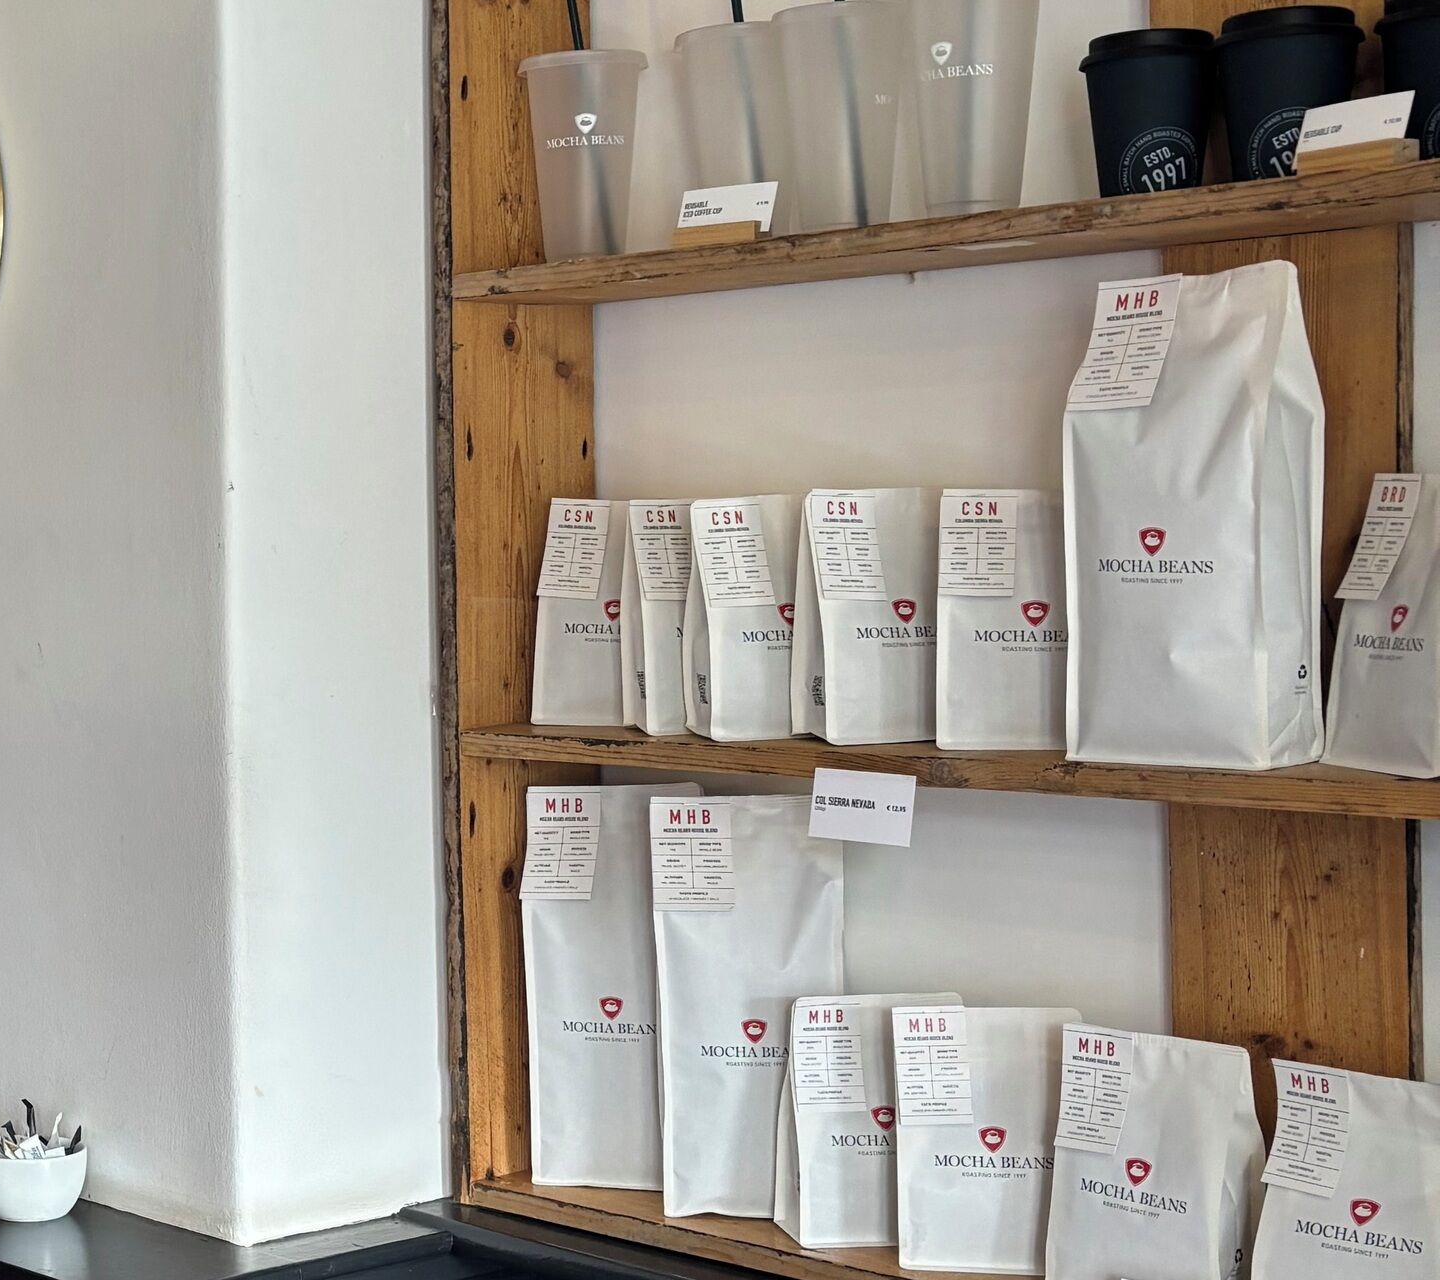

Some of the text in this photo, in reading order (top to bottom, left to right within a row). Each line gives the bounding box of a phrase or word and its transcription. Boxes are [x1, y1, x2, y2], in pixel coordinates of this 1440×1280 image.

[947, 64, 994, 78] BEANS
[546, 135, 625, 150] MOCHA BEANS
[1143, 146, 1175, 168] ESTD.
[1141, 156, 1186, 192] 1997
[564, 509, 593, 523] CSN
[827, 501, 857, 516] CSN
[962, 501, 997, 516] CSN
[646, 510, 676, 523] CSN
[711, 511, 743, 526] CSN
[1098, 559, 1213, 574] MOCHA BEANS
[564, 623, 613, 634] MOCHA
[856, 626, 911, 639] MOCHA
[974, 630, 1037, 642] MOCHA
[1354, 634, 1424, 652] MOCHA BEANS
[828, 796, 850, 807] SIERRA
[851, 799, 875, 810] NEVADA
[562, 1021, 657, 1034] MOCHA BEAN
[701, 1046, 789, 1057] MOCHA BEA
[831, 1134, 890, 1147] MOCHA
[934, 1155, 1054, 1170] MOCHA BEANS
[1080, 1177, 1187, 1214] MOCHA BEANS
[1103, 1200, 1129, 1212] ROASTING
[1130, 1207, 1146, 1216] SINCE
[1295, 1219, 1423, 1255] MOCHA BEANS
[1321, 1242, 1352, 1253] ROASTING
[1354, 1248, 1372, 1257] SINCE
